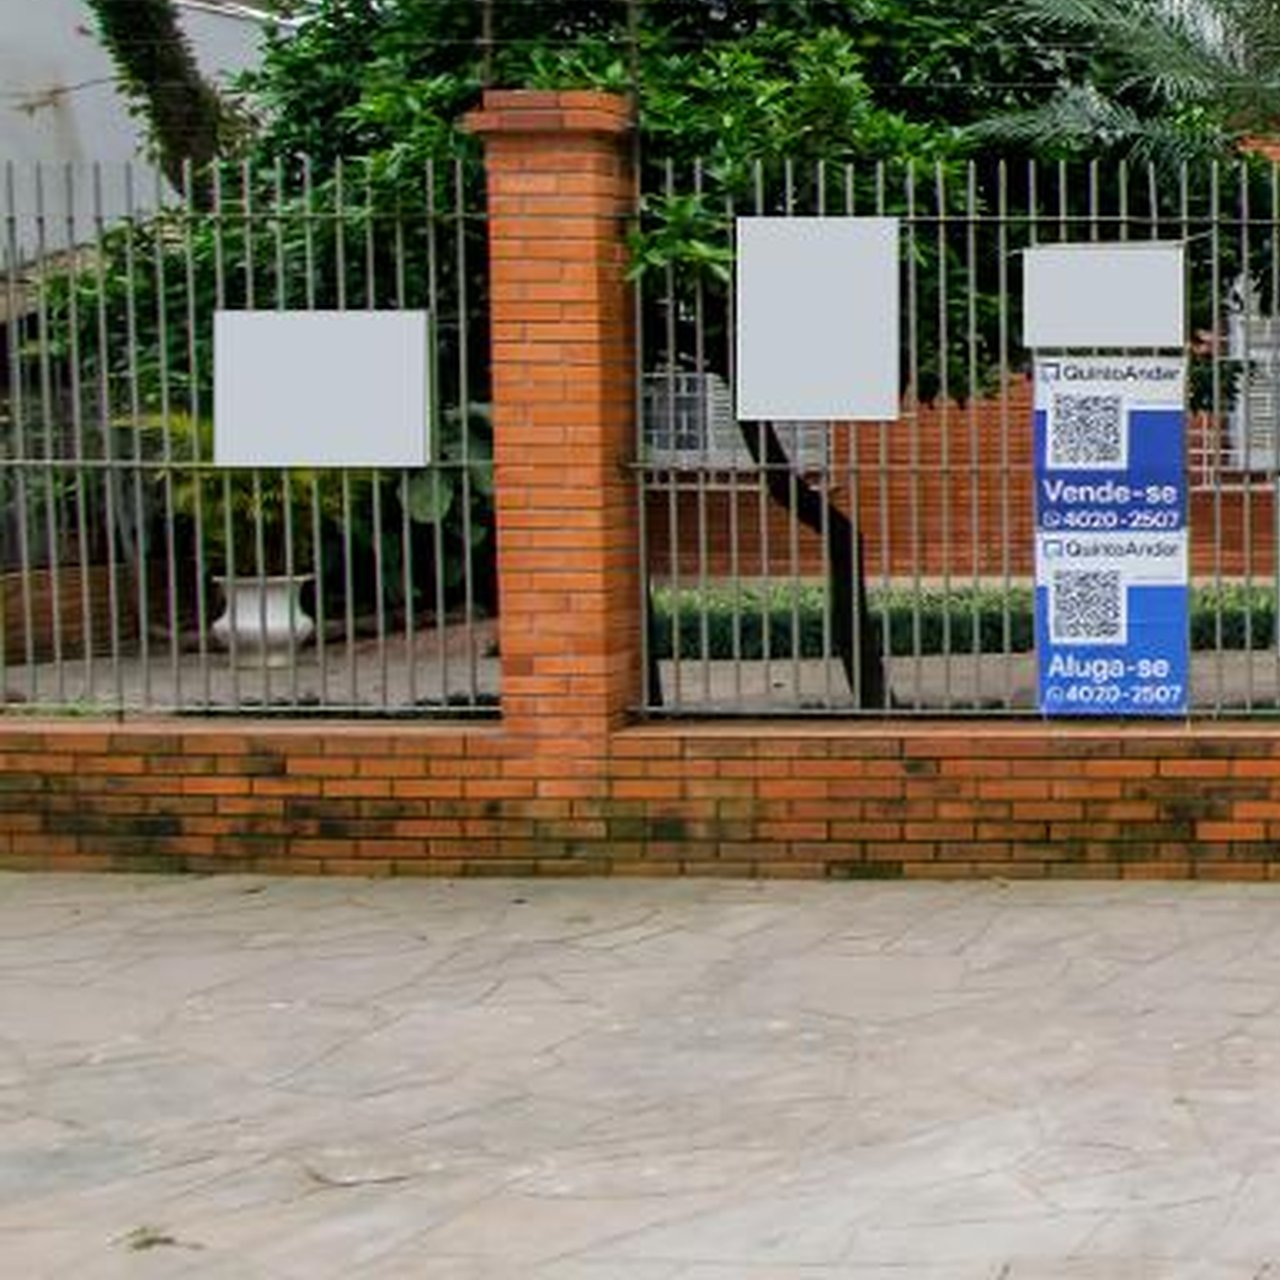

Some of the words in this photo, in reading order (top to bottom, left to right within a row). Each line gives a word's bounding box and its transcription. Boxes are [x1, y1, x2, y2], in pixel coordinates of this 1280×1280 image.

[1063, 365, 1180, 381] QuintoAndar
[1042, 480, 1178, 504] Vende-se
[1063, 509, 1179, 528] 4020-2507
[1049, 653, 1170, 683] Aluga-se
[1066, 685, 1182, 704] 4020-2507
